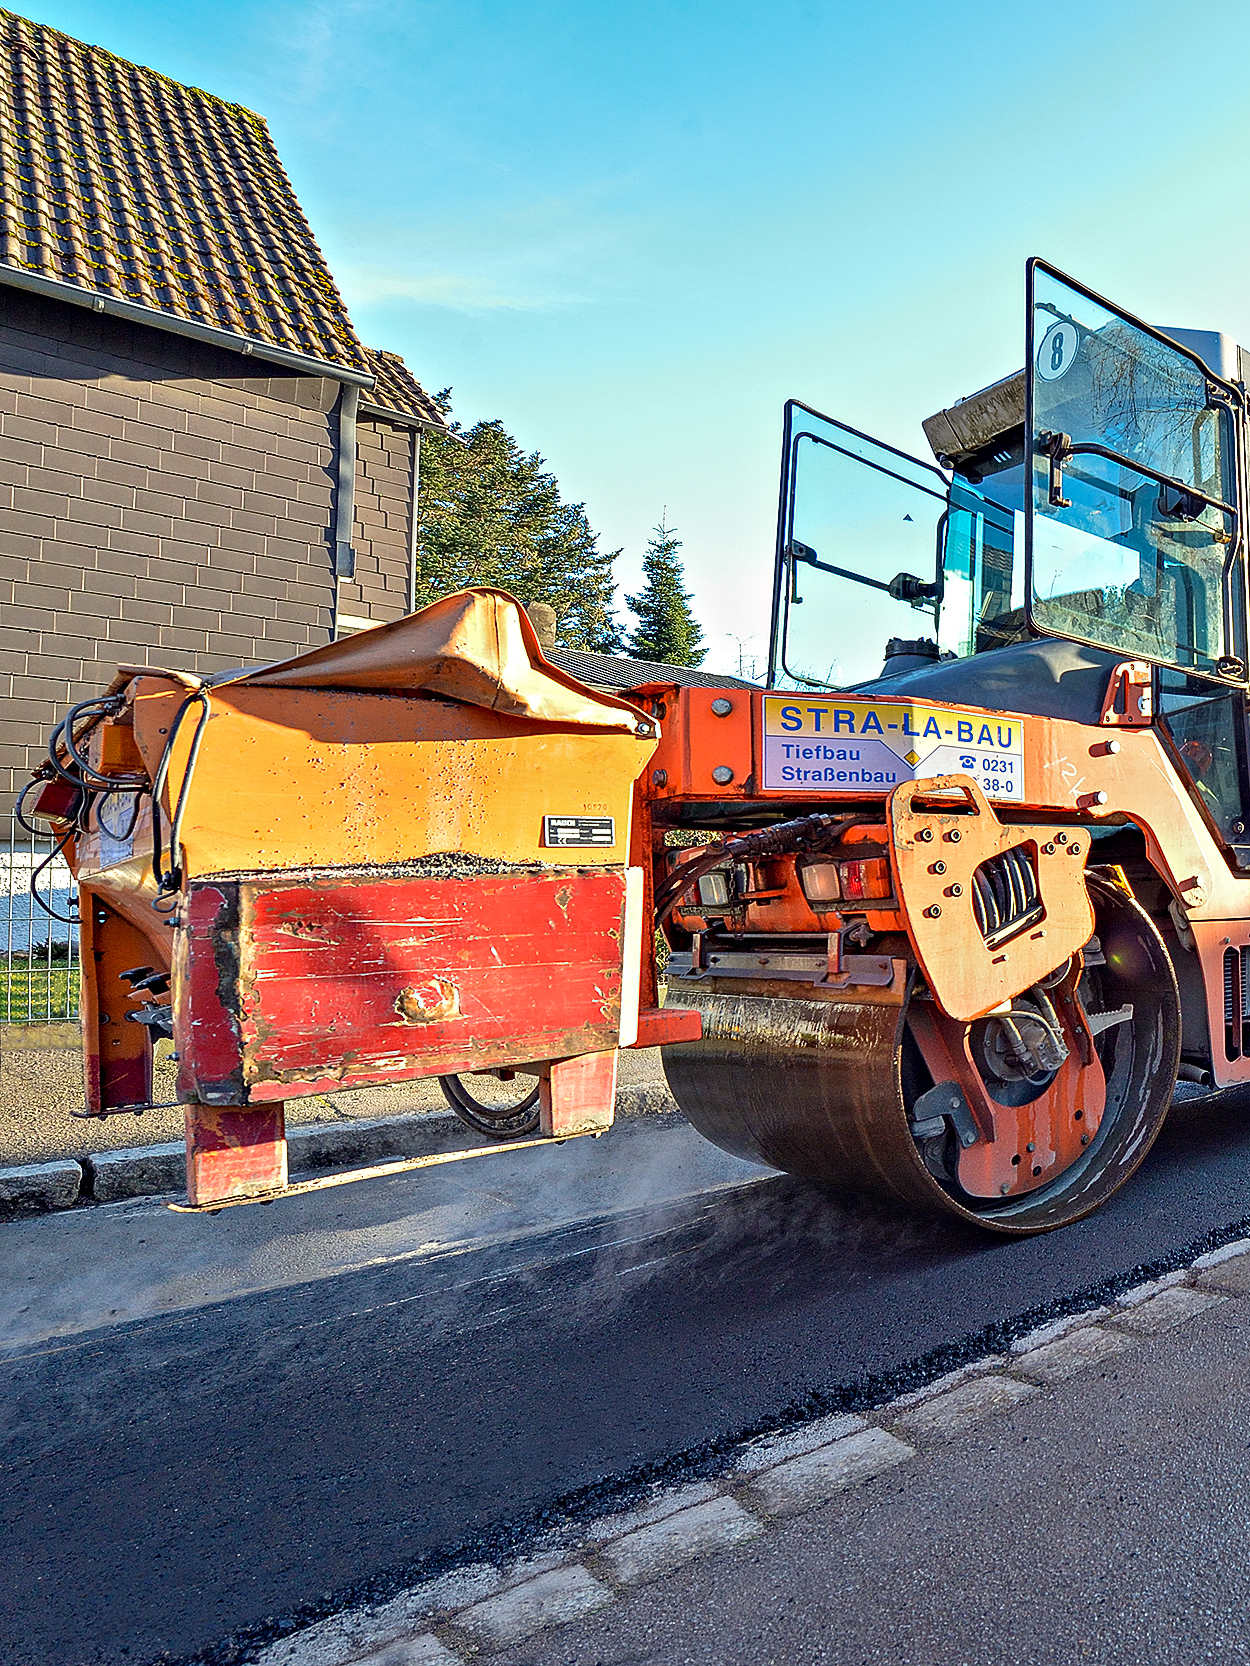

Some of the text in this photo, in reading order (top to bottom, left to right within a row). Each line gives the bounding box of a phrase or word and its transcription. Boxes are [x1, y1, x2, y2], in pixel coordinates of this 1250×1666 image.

[1050, 332, 1064, 370] 8
[780, 706, 1012, 749] STRA-LA-BAU
[782, 744, 861, 761] Tiefbau
[782, 766, 897, 784] Straßenbau
[983, 758, 1014, 774] 0231
